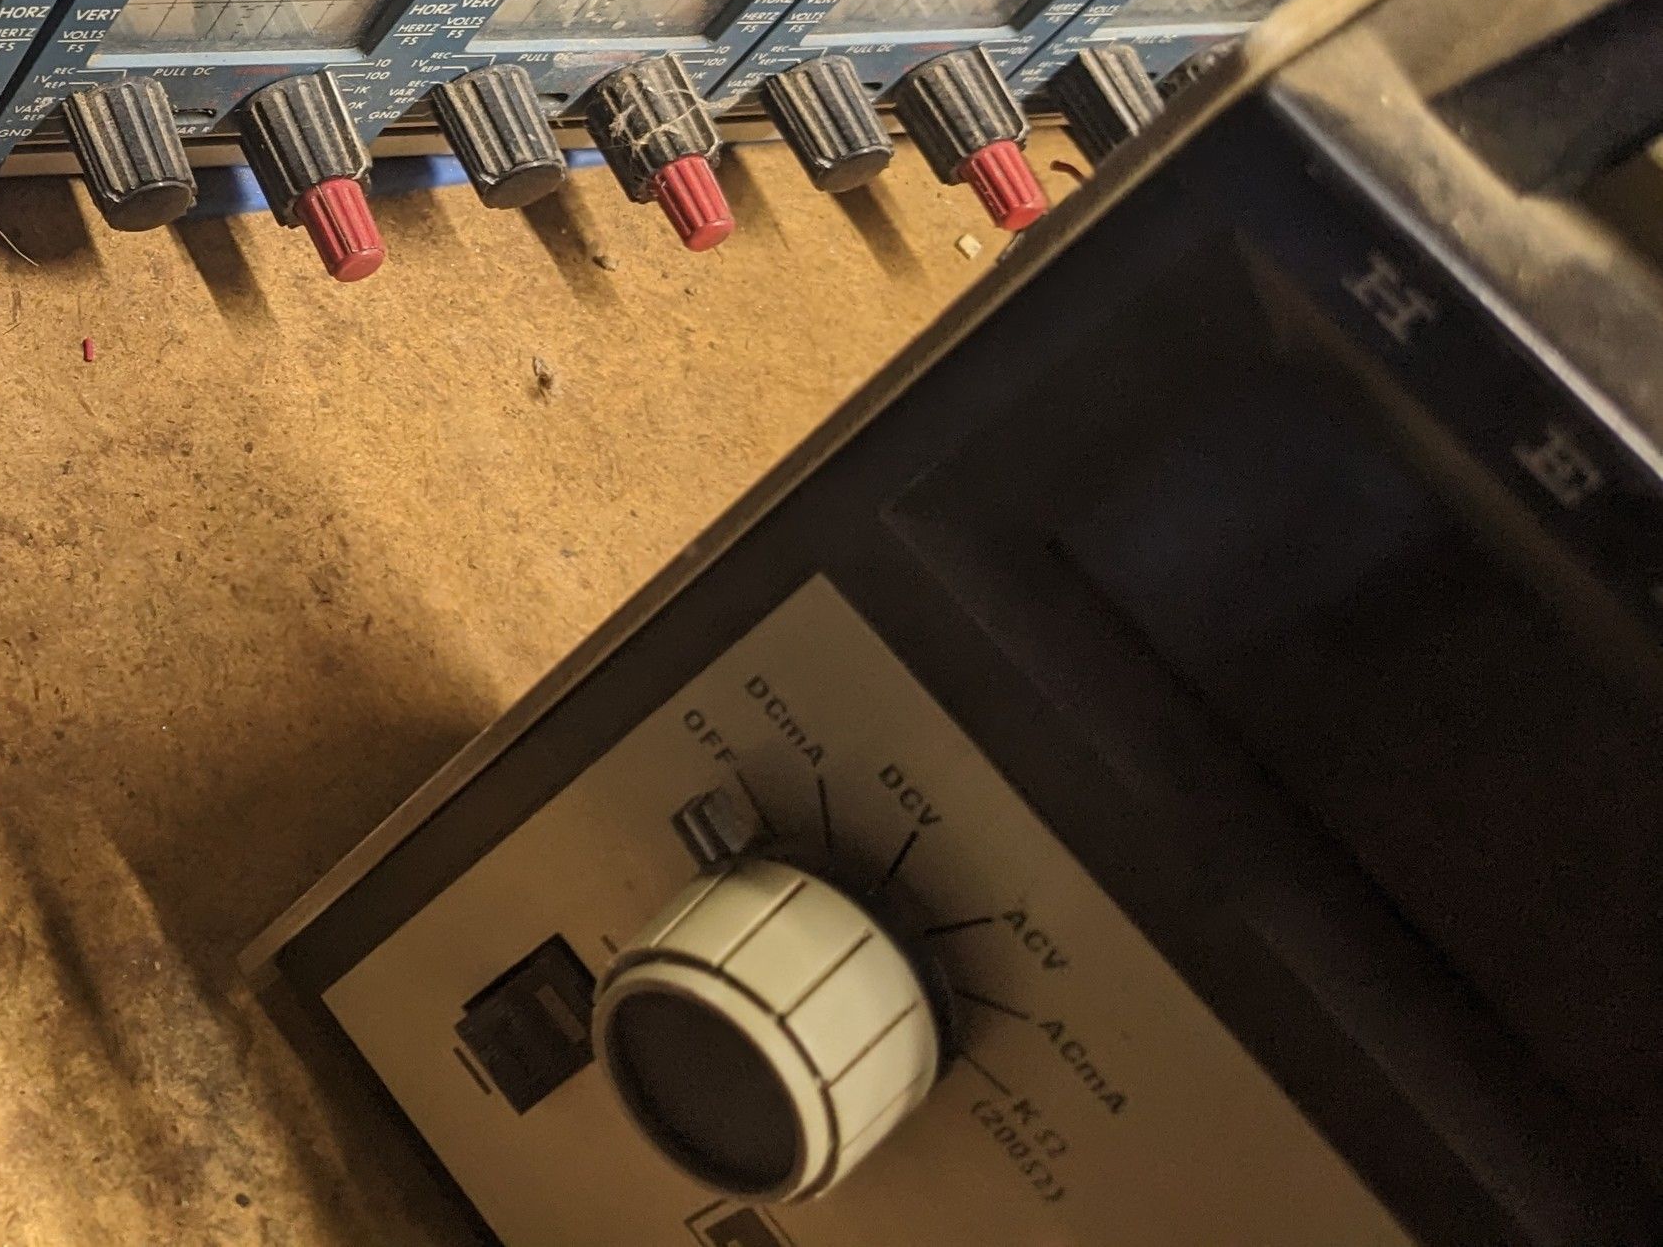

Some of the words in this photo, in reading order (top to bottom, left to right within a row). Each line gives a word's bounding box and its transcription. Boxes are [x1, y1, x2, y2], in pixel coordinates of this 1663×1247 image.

[409, 3, 458, 16] HORZ
[76, 9, 122, 21] VERT
[741, 11, 781, 21] HERTZ
[790, 11, 826, 21] VOLTS
[446, 16, 486, 26] VOLTS
[398, 23, 441, 33] HERTZ
[741, 24, 759, 33] FS
[62, 30, 106, 40] VOLTS
[447, 30, 465, 39] FS
[401, 37, 419, 46] FS
[67, 43, 85, 53] FS
[430, 51, 453, 60] REC
[518, 53, 547, 62] PULL
[374, 58, 393, 68] 10
[53, 67, 76, 75] REC
[153, 68, 187, 77] PULL
[193, 66, 216, 76] DC
[364, 71, 391, 81] 100
[44, 81, 67, 89] REP
[389, 88, 416, 97] VAR
[15, 105, 43, 114] VAR
[368, 110, 401, 120] GND
[744, 674, 824, 768] DCmA
[683, 709, 738, 764] OFF
[878, 763, 943, 827] DCV
[1002, 909, 1071, 971] ACV
[1038, 1019, 1128, 1115] ACmA
